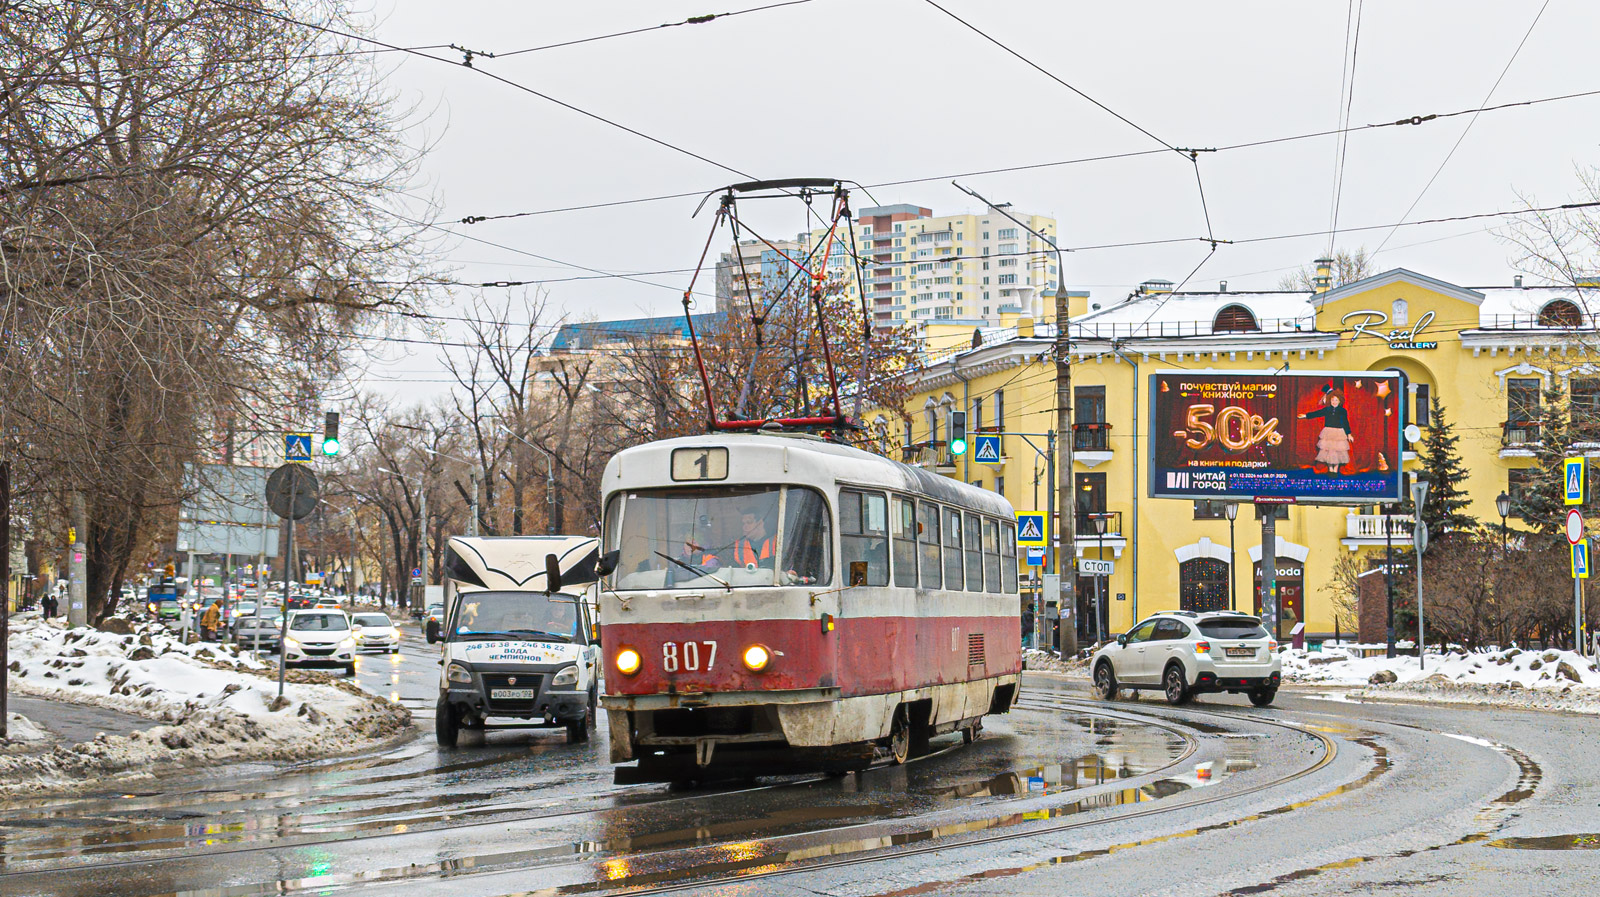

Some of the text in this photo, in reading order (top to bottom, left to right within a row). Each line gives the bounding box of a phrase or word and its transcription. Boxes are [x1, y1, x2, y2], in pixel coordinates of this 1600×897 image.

[1341, 309, 1436, 343] Real
[1180, 382, 1240, 392] почувствуй
[1202, 391, 1254, 399] книжного
[1173, 404, 1282, 450] -50%
[694, 454, 707, 478] 1
[1192, 471, 1226, 480] ЧИТАЙ
[1193, 481, 1226, 490] ГОРОД
[1084, 561, 1110, 572] СТОП
[466, 643, 482, 651] 246
[554, 644, 565, 652] 22
[663, 641, 717, 672] 807
